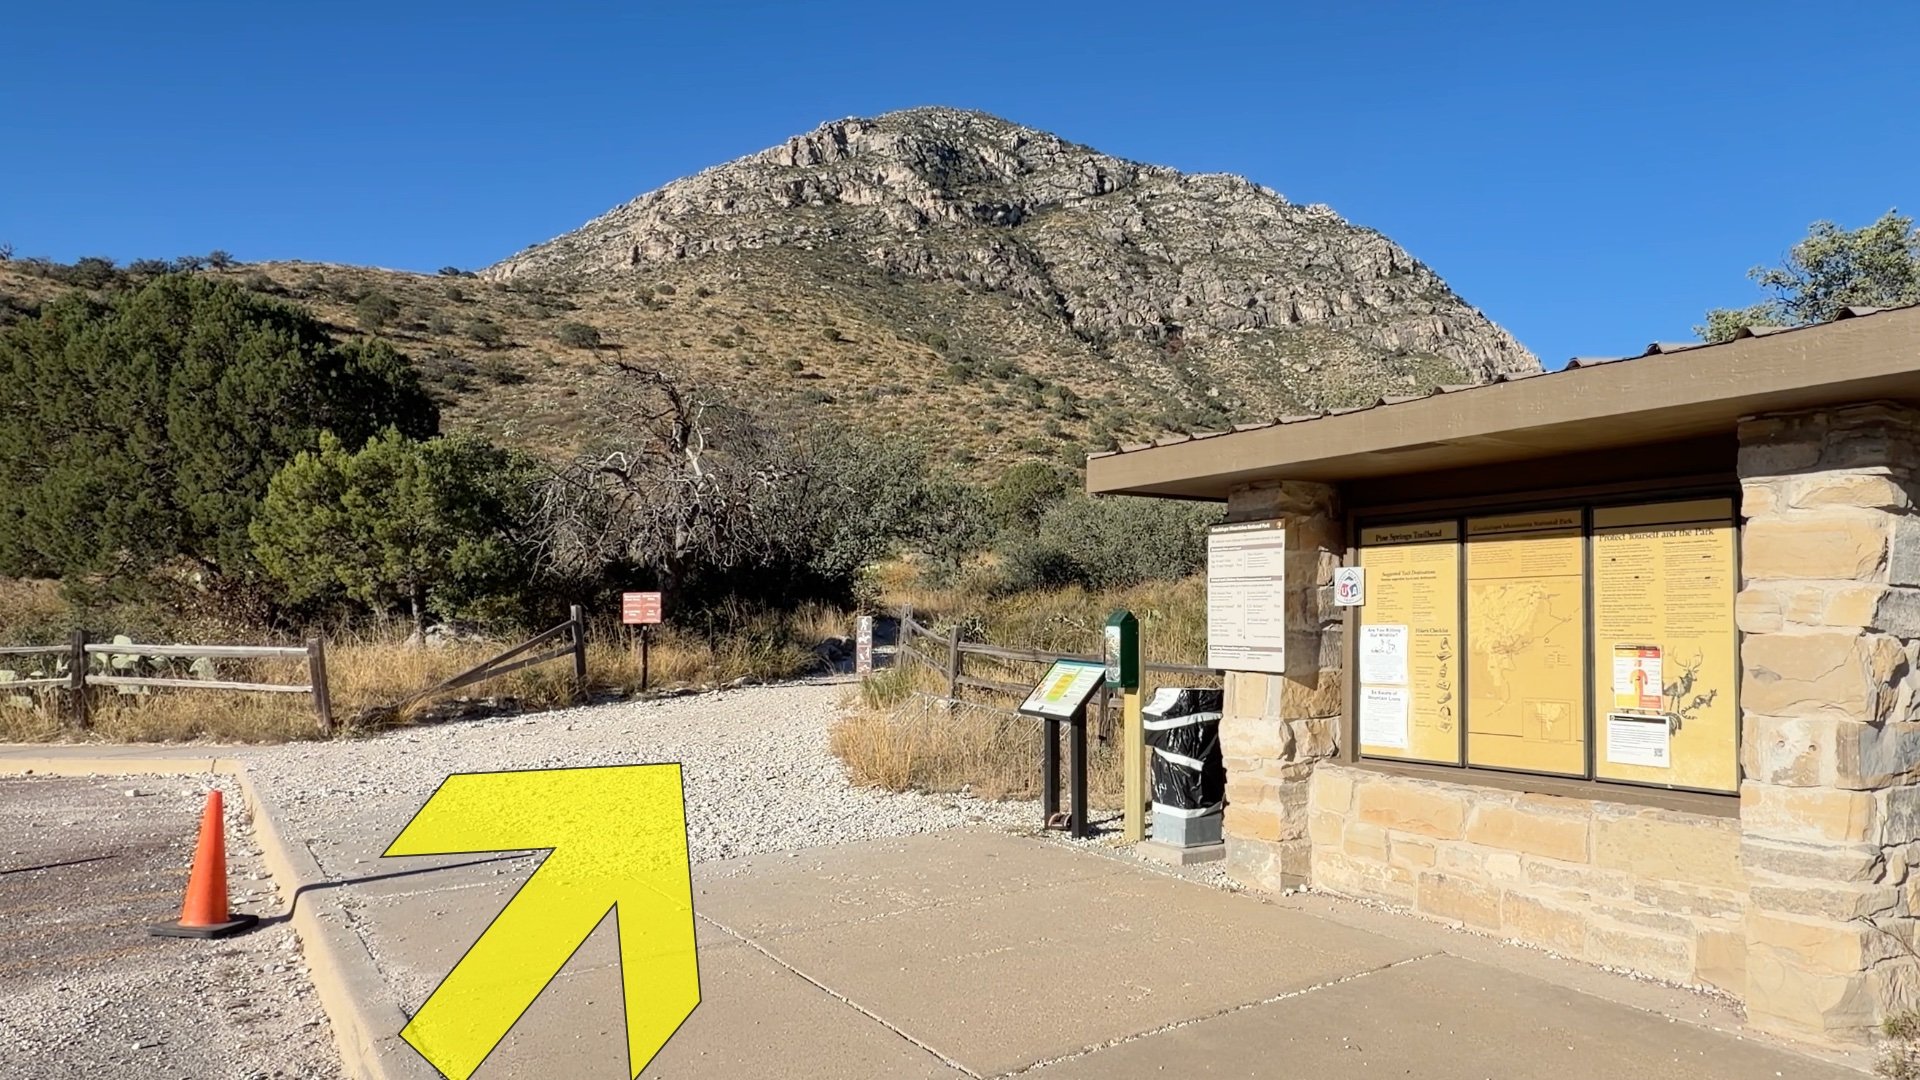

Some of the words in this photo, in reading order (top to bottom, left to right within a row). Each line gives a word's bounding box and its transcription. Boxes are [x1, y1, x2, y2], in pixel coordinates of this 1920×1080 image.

[1376, 534, 1388, 542] Pine
[1390, 532, 1412, 541] Springs
[1413, 529, 1442, 538] Trailhead
[1599, 533, 1625, 542] Protect
[1629, 531, 1659, 540] Yourself
[1661, 529, 1676, 538] and
[1679, 528, 1691, 537] the
[1695, 527, 1714, 536] Park
